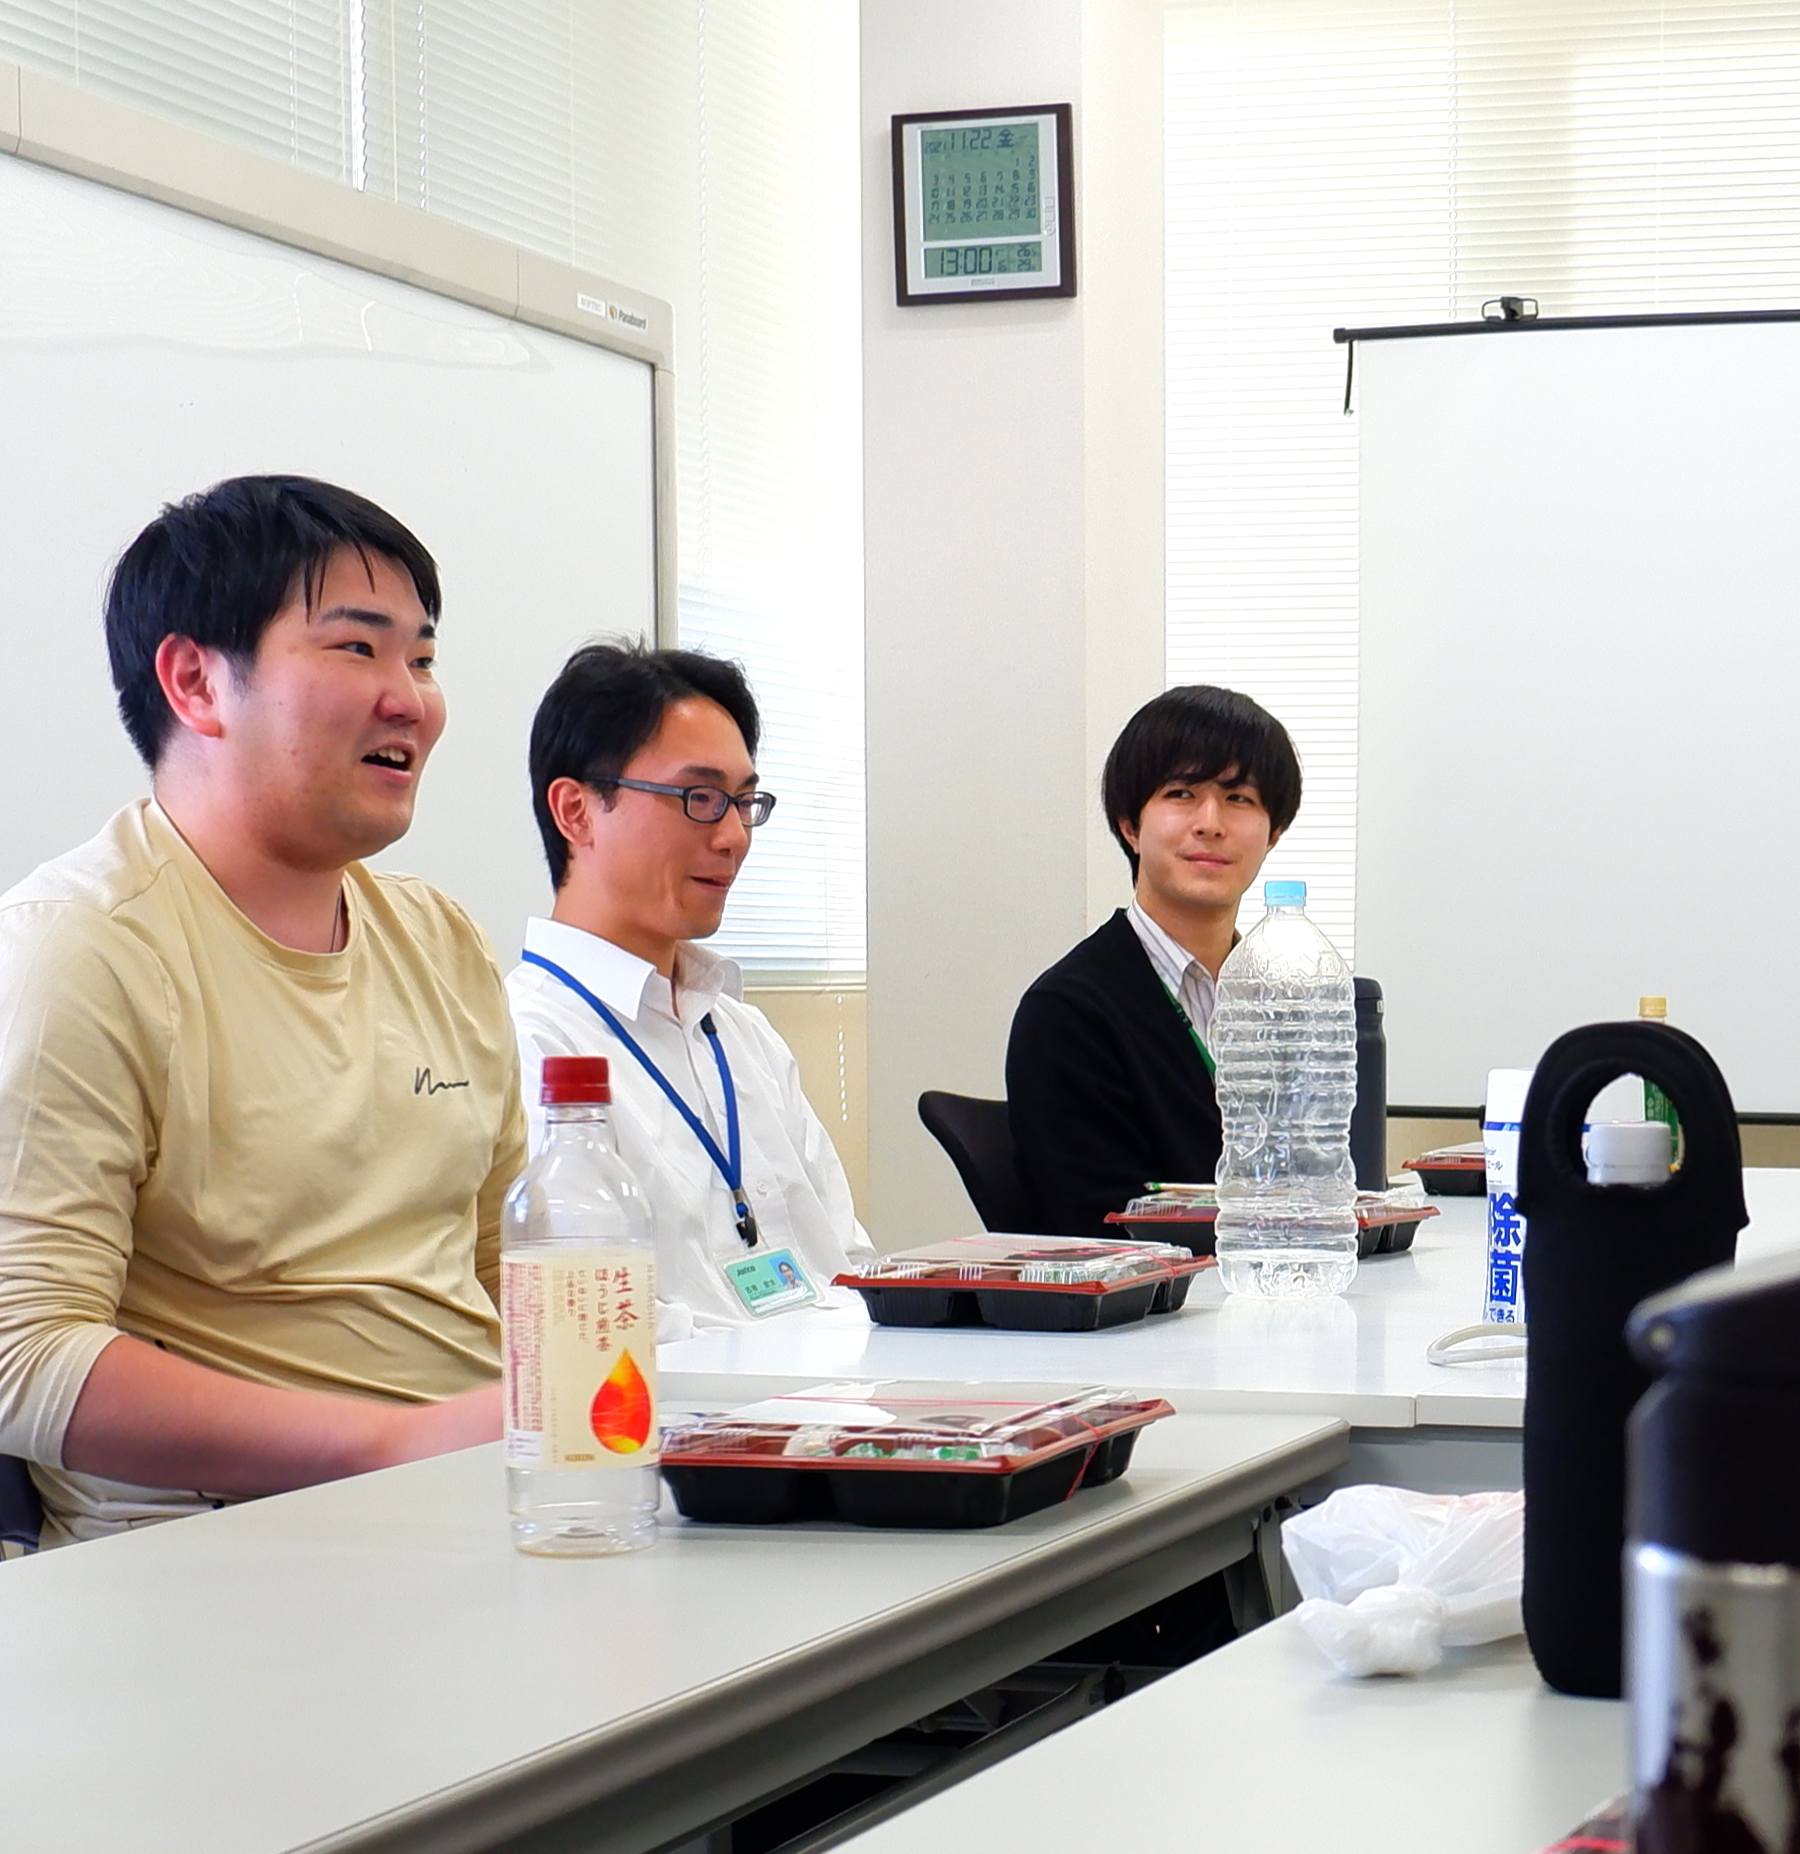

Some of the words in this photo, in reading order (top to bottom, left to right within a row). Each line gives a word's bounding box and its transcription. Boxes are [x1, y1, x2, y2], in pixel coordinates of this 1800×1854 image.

[940, 246, 993, 276] 13:00
[1489, 1192, 1522, 1305] 除菌
[612, 1266, 639, 1330] 生茶
[1489, 1307, 1515, 1323] できる
